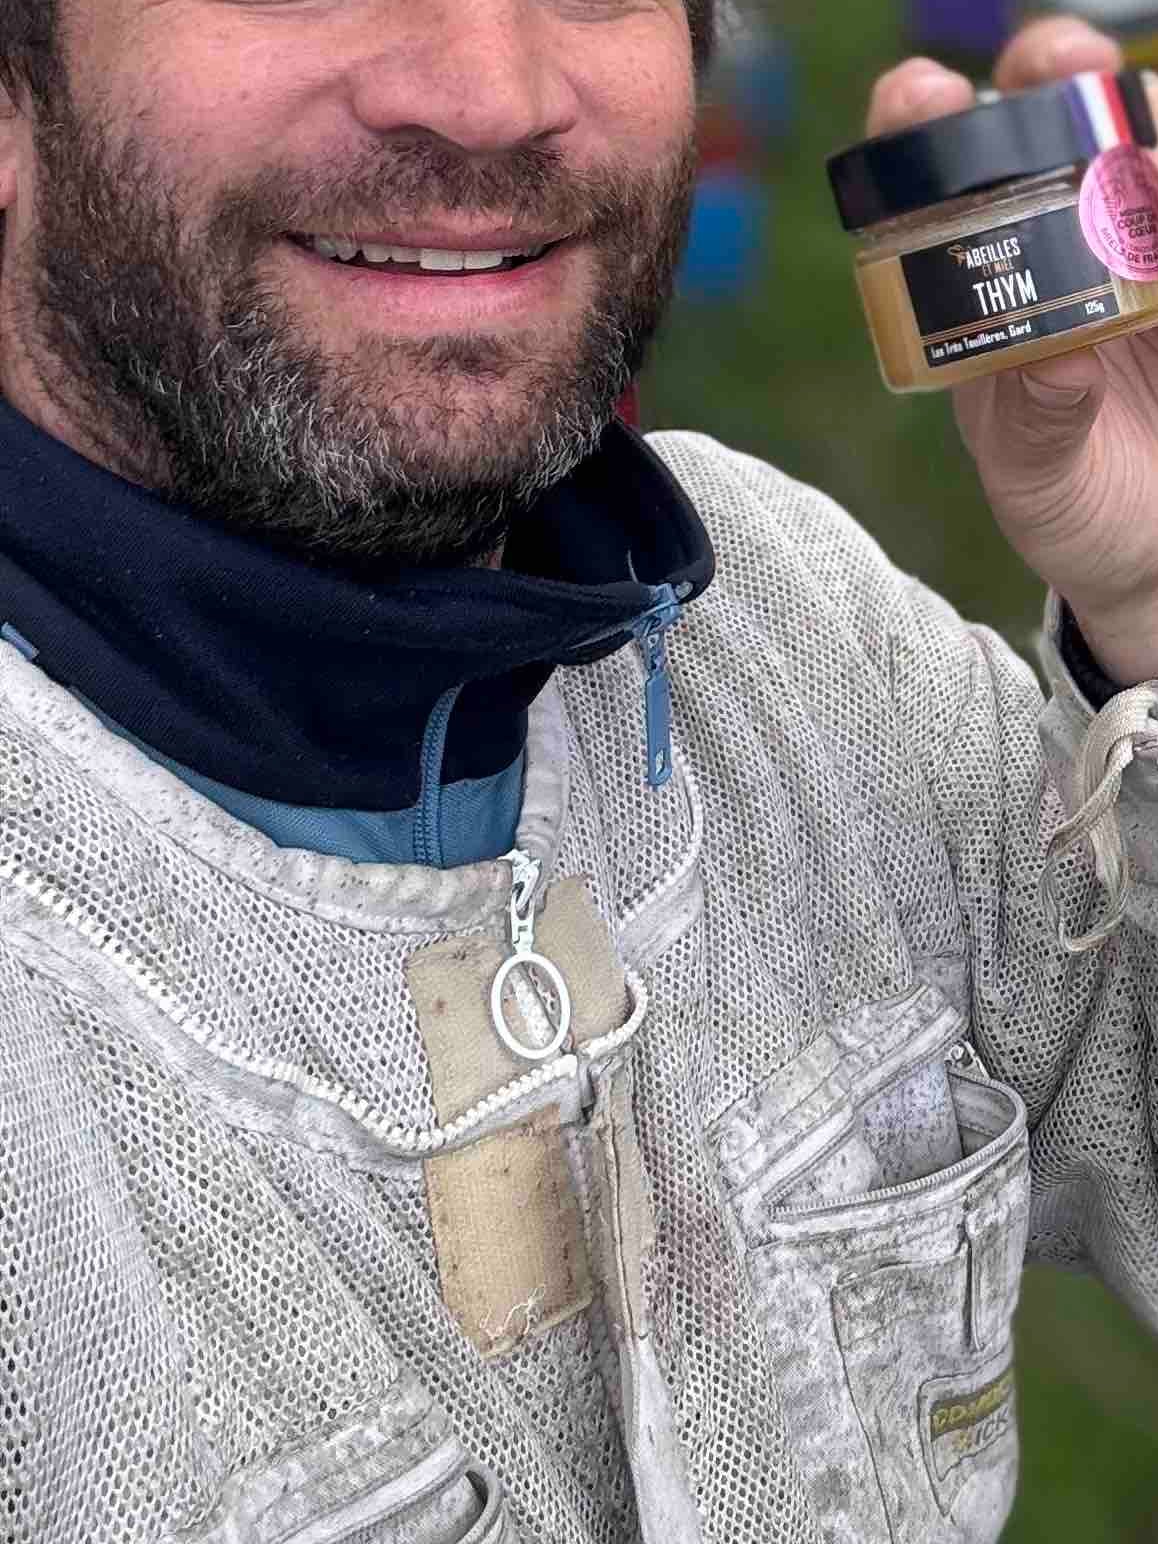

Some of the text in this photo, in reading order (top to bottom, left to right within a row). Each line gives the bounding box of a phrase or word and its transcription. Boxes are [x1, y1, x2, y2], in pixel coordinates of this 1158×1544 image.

[965, 237, 1021, 269] ABEILLES
[1127, 252, 1141, 264] DE
[972, 268, 1038, 316] THYM
[1008, 319, 1033, 338] Gard
